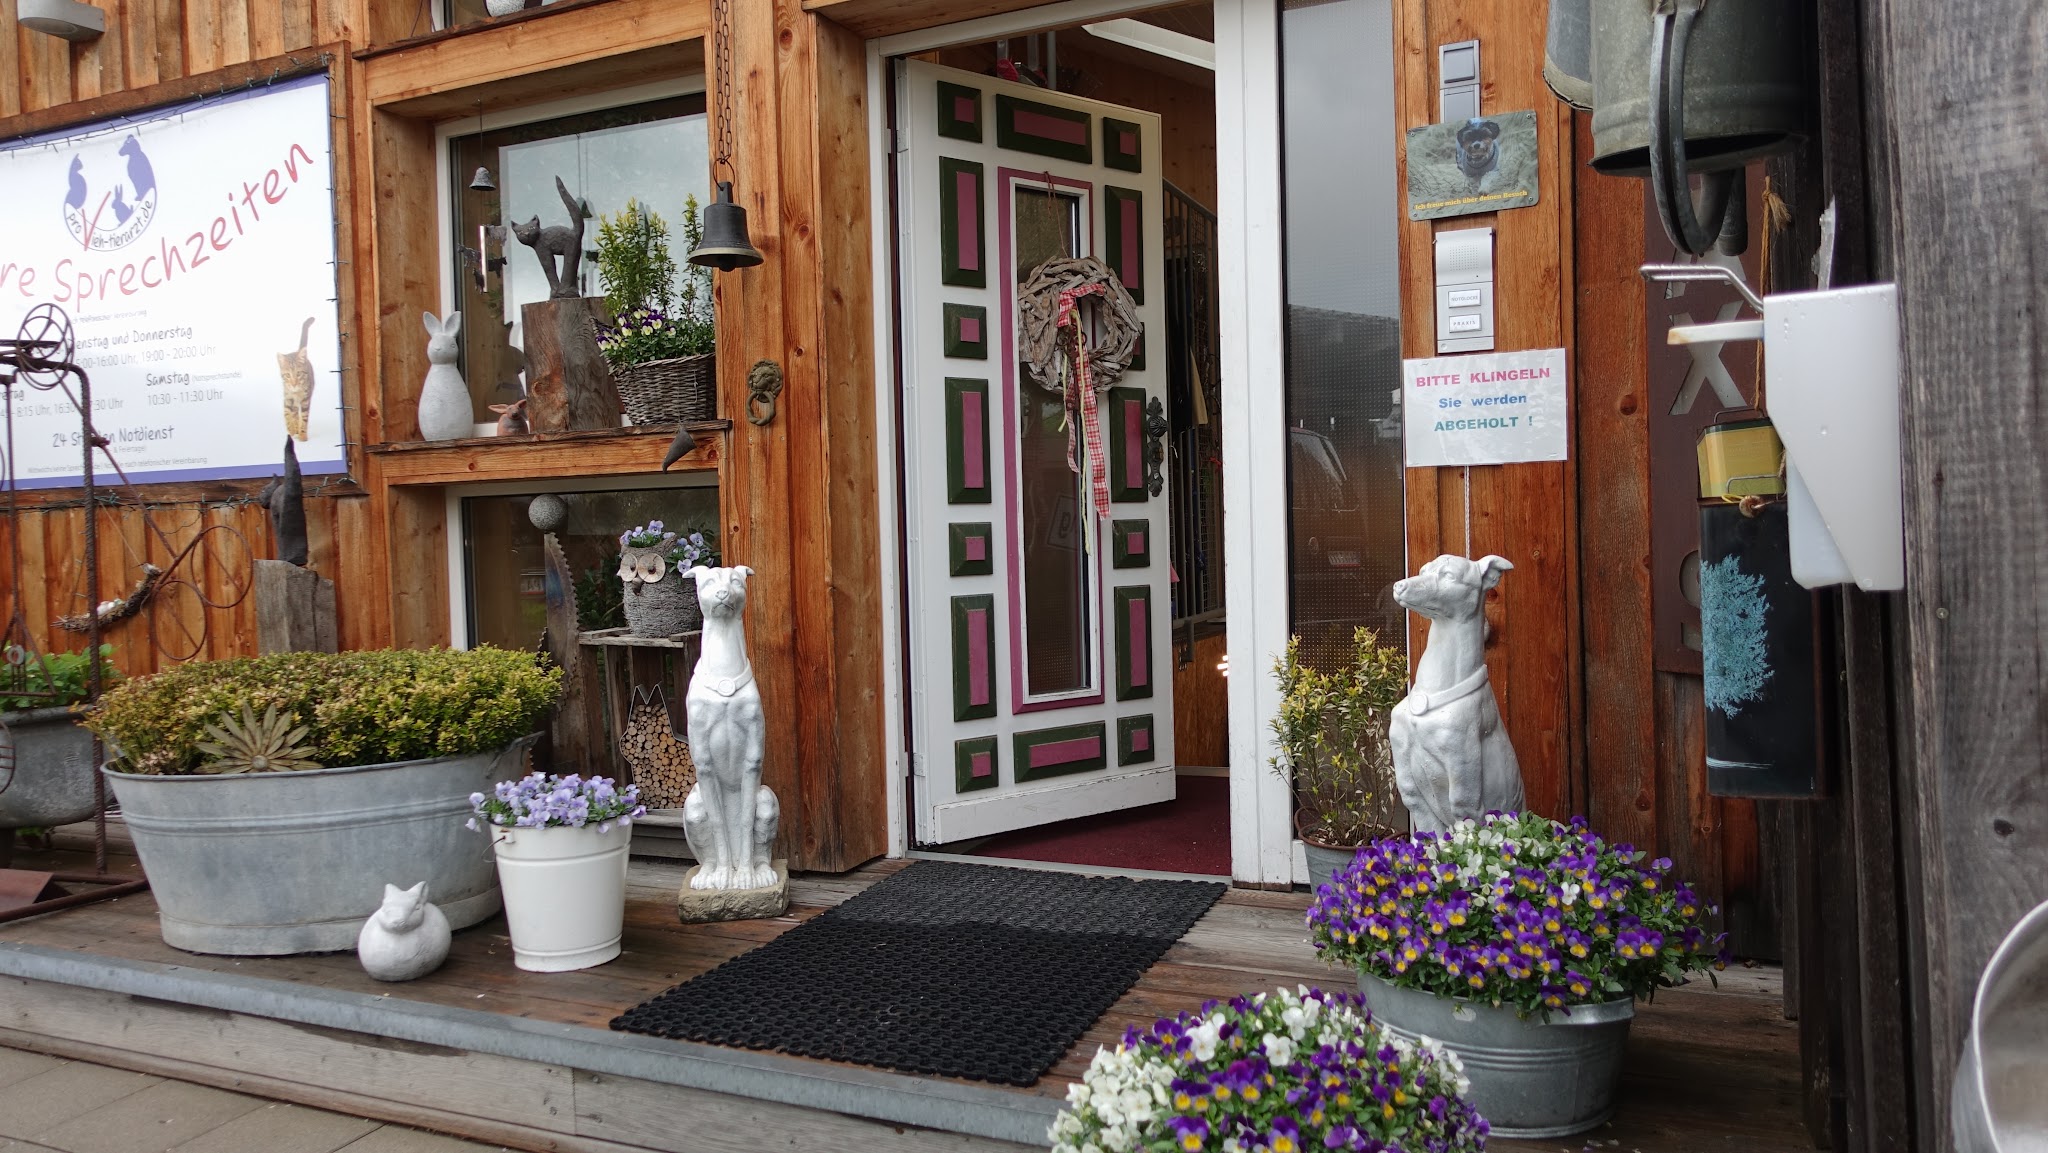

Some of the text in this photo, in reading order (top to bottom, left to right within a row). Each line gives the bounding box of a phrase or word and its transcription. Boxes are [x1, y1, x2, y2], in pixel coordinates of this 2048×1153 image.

[1426, 201, 1444, 209] freue
[1462, 196, 1478, 204] über
[1479, 194, 1502, 202] deinen
[1503, 190, 1528, 198] Besuch
[53, 143, 313, 312] Sprechzeiten
[112, 332, 129, 345] und
[133, 326, 193, 343] Donnerstag
[146, 372, 190, 387] Samstag
[1416, 368, 1550, 387] BITTE KLINGELN
[148, 393, 171, 406] 10:30
[180, 390, 204, 403] 11:30
[206, 389, 223, 401] Uhr
[1438, 394, 1527, 408] Sie werden
[1434, 416, 1533, 432] ABGEHOLT !
[53, 432, 67, 447] 24
[119, 425, 175, 442] Notdienst
